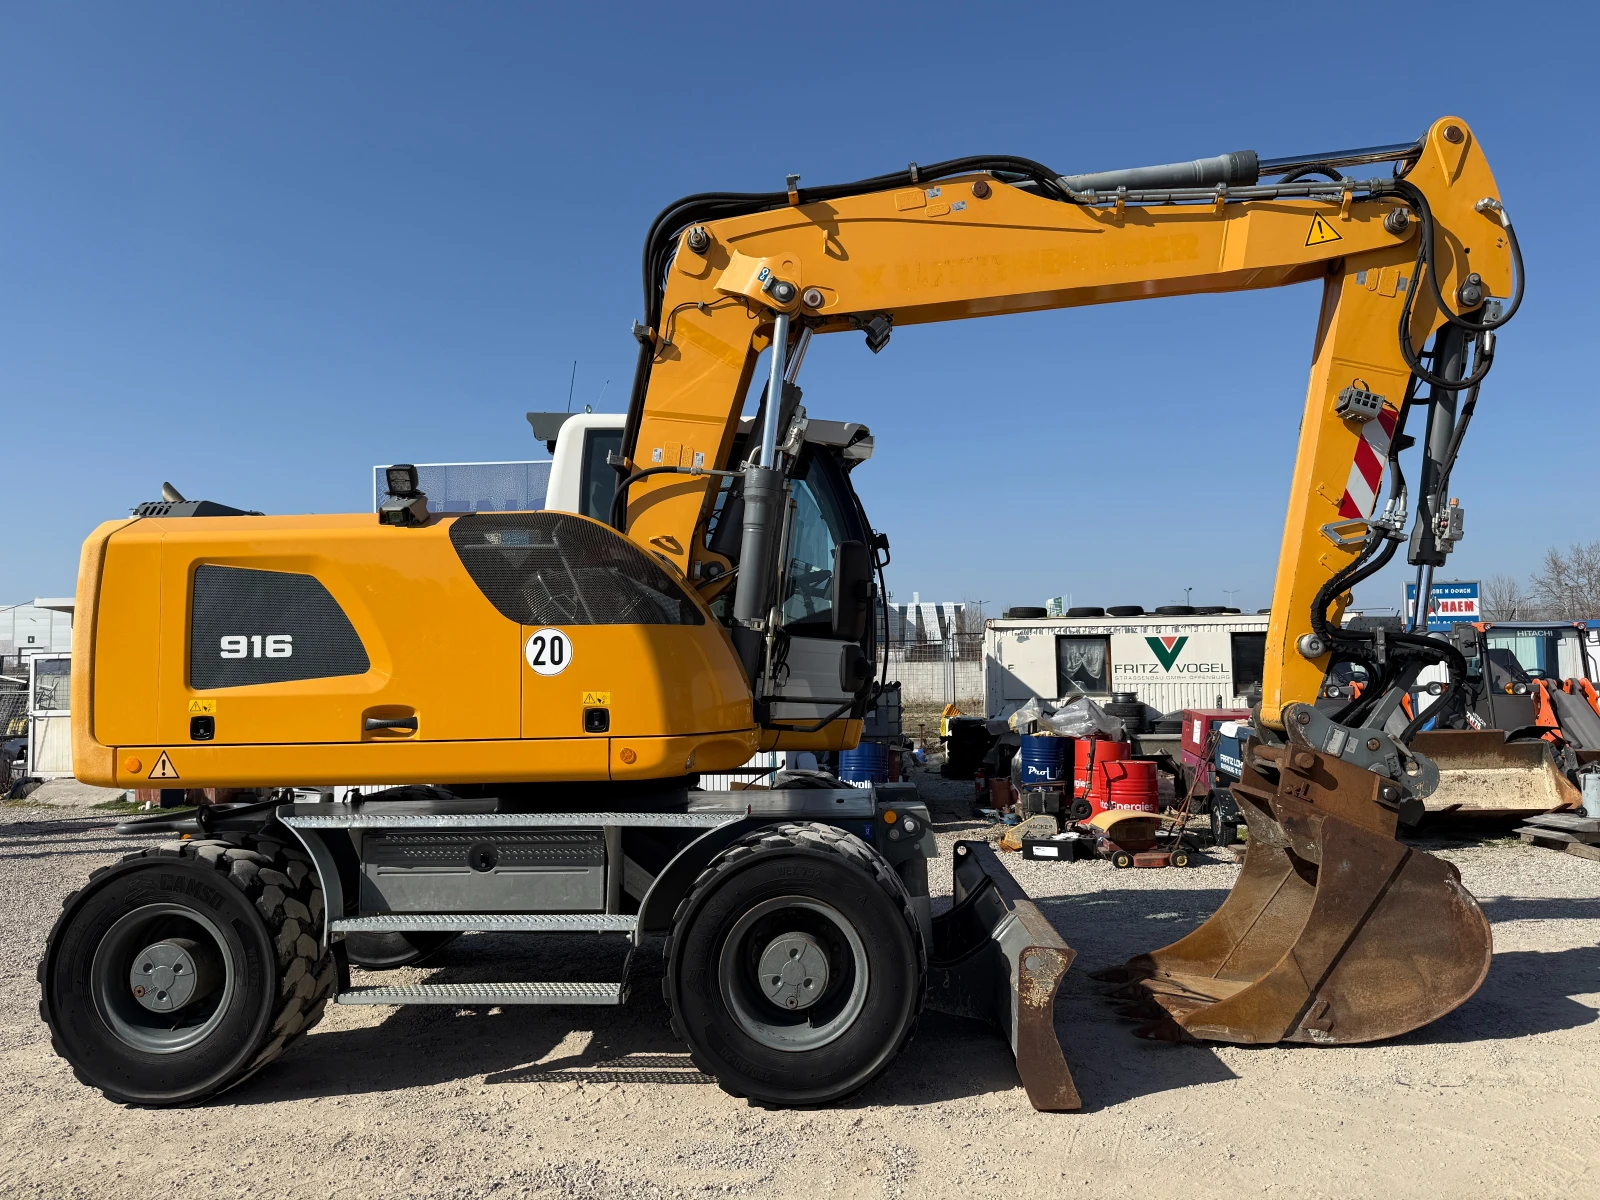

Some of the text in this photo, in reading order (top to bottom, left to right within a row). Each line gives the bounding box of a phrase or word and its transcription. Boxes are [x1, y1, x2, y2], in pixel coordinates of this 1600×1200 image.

[1441, 600, 1475, 613] НАЕМ
[220, 634, 293, 659] 916
[532, 635, 564, 666] 20
[1114, 663, 1230, 674] FRITZ VOGEL
